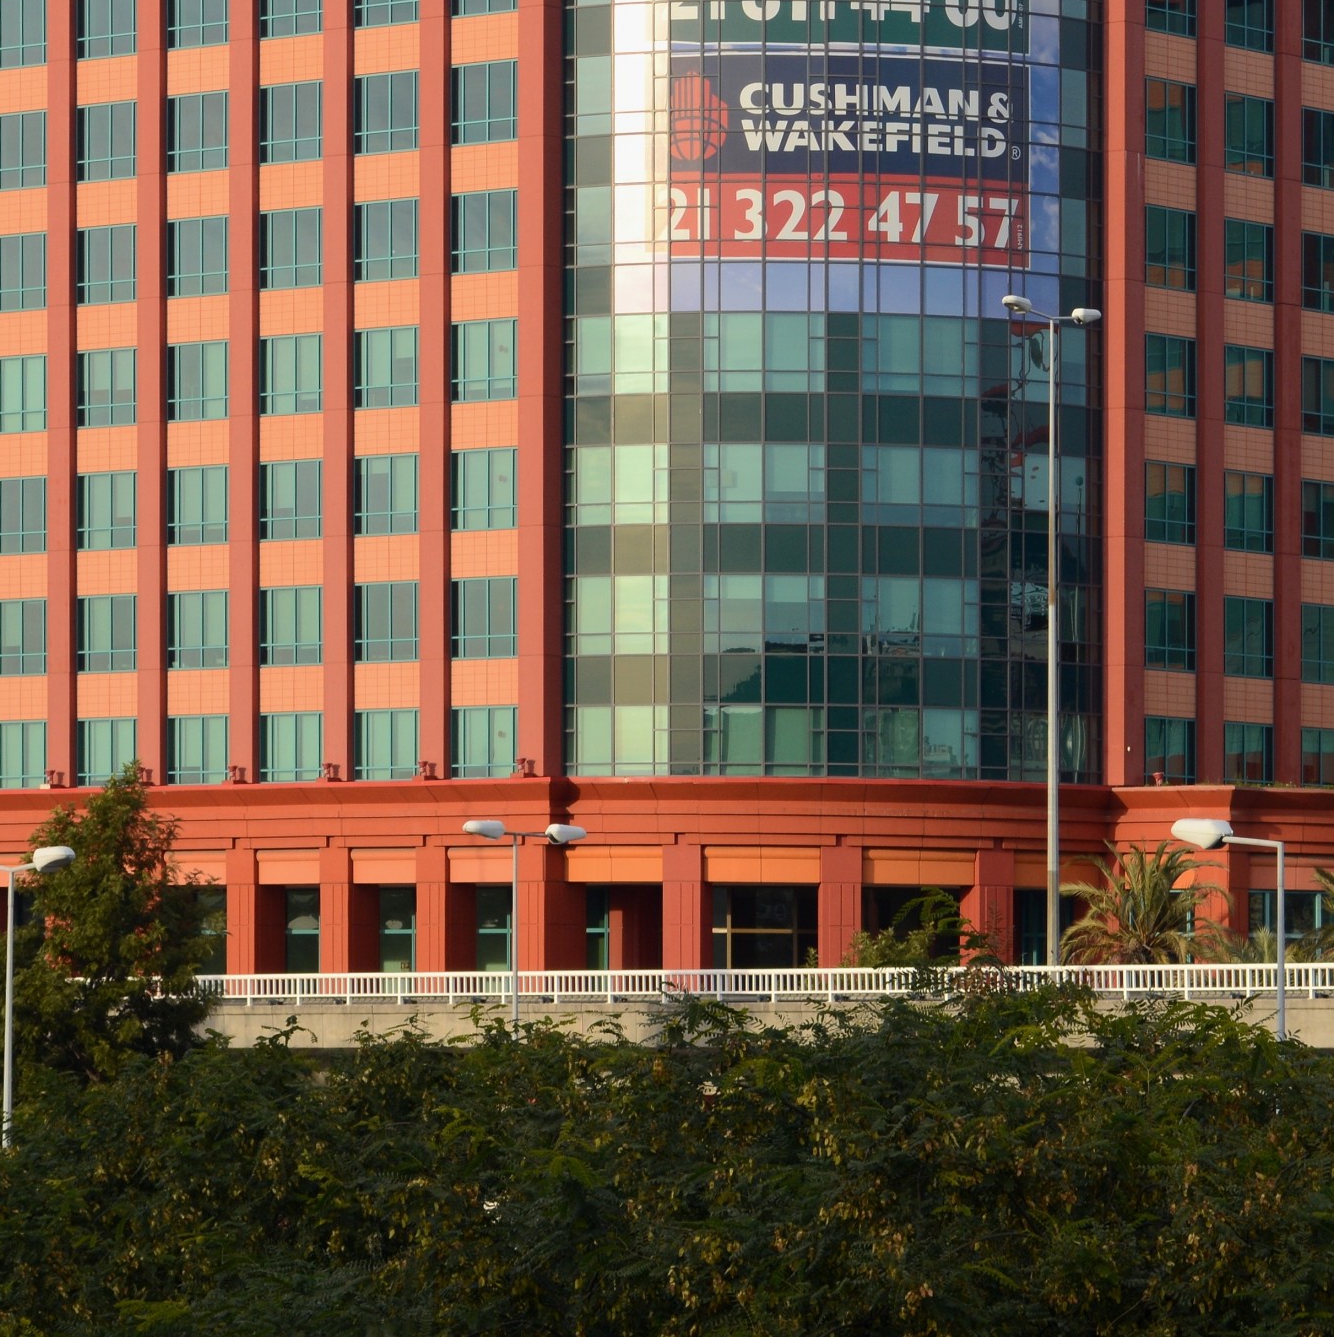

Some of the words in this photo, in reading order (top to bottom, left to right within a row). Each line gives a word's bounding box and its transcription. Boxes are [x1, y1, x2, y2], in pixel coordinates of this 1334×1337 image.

[739, 82, 979, 121] CUSHMAN
[986, 91, 1011, 125] &
[740, 118, 1007, 158] WAKEFIELD
[657, 187, 710, 241] 21
[734, 188, 848, 241] 322
[868, 190, 939, 244] 47
[954, 194, 1018, 248] 57
